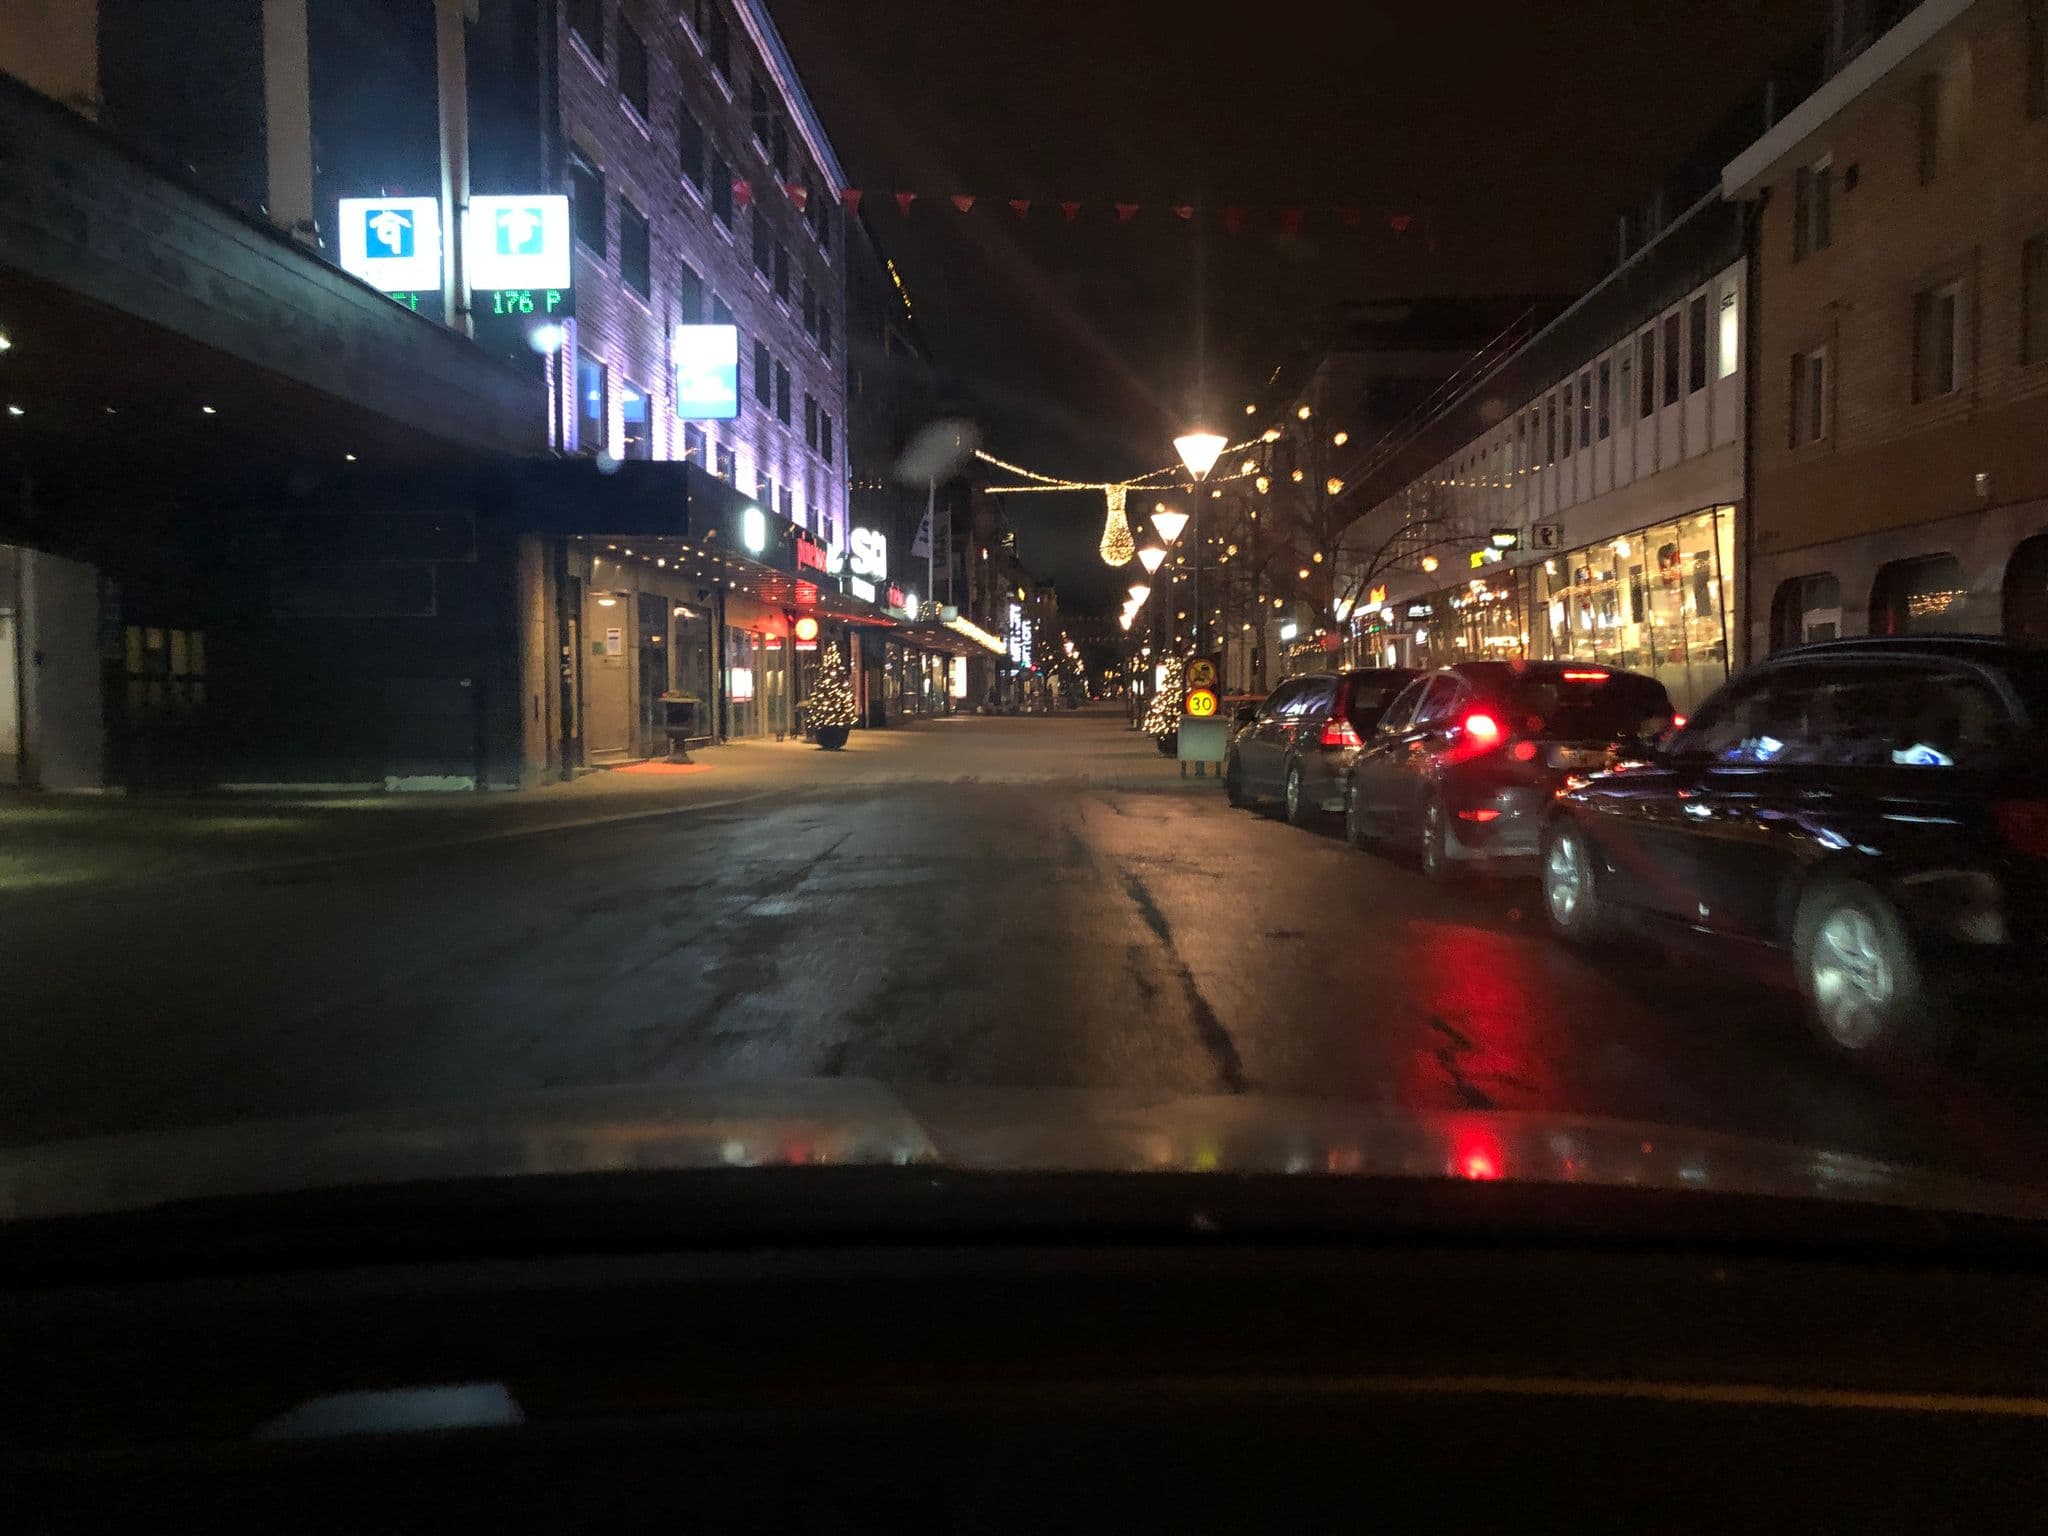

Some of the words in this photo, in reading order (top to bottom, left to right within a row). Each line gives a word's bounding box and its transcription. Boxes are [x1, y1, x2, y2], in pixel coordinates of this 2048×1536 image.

[494, 289, 534, 314] 176
[547, 289, 561, 313] P
[1192, 697, 1212, 711] 30
